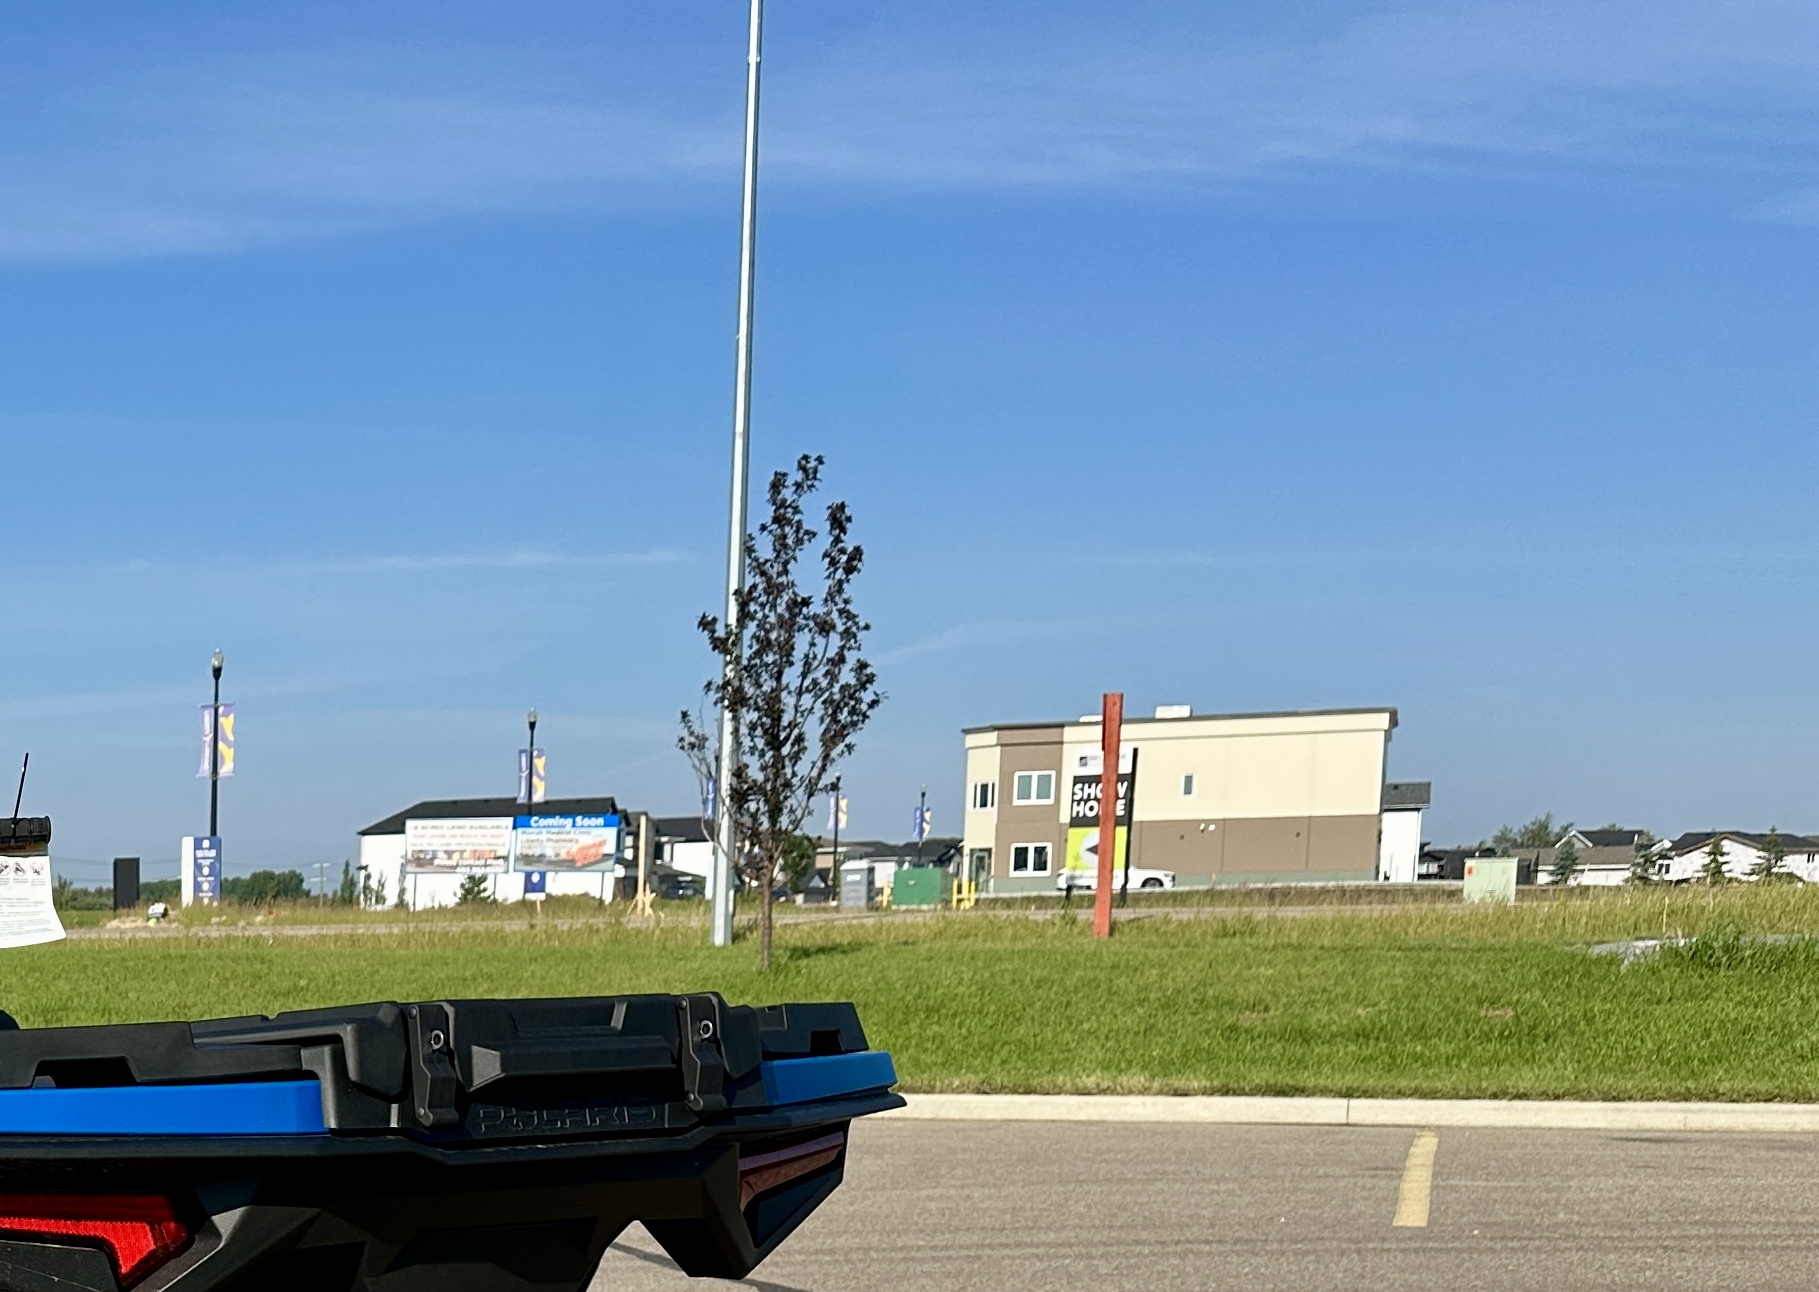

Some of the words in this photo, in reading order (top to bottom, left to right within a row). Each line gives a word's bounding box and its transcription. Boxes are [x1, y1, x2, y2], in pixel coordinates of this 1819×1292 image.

[1071, 799, 1126, 818] HOE
[530, 815, 573, 830] Coming
[575, 815, 605, 827] Soon
